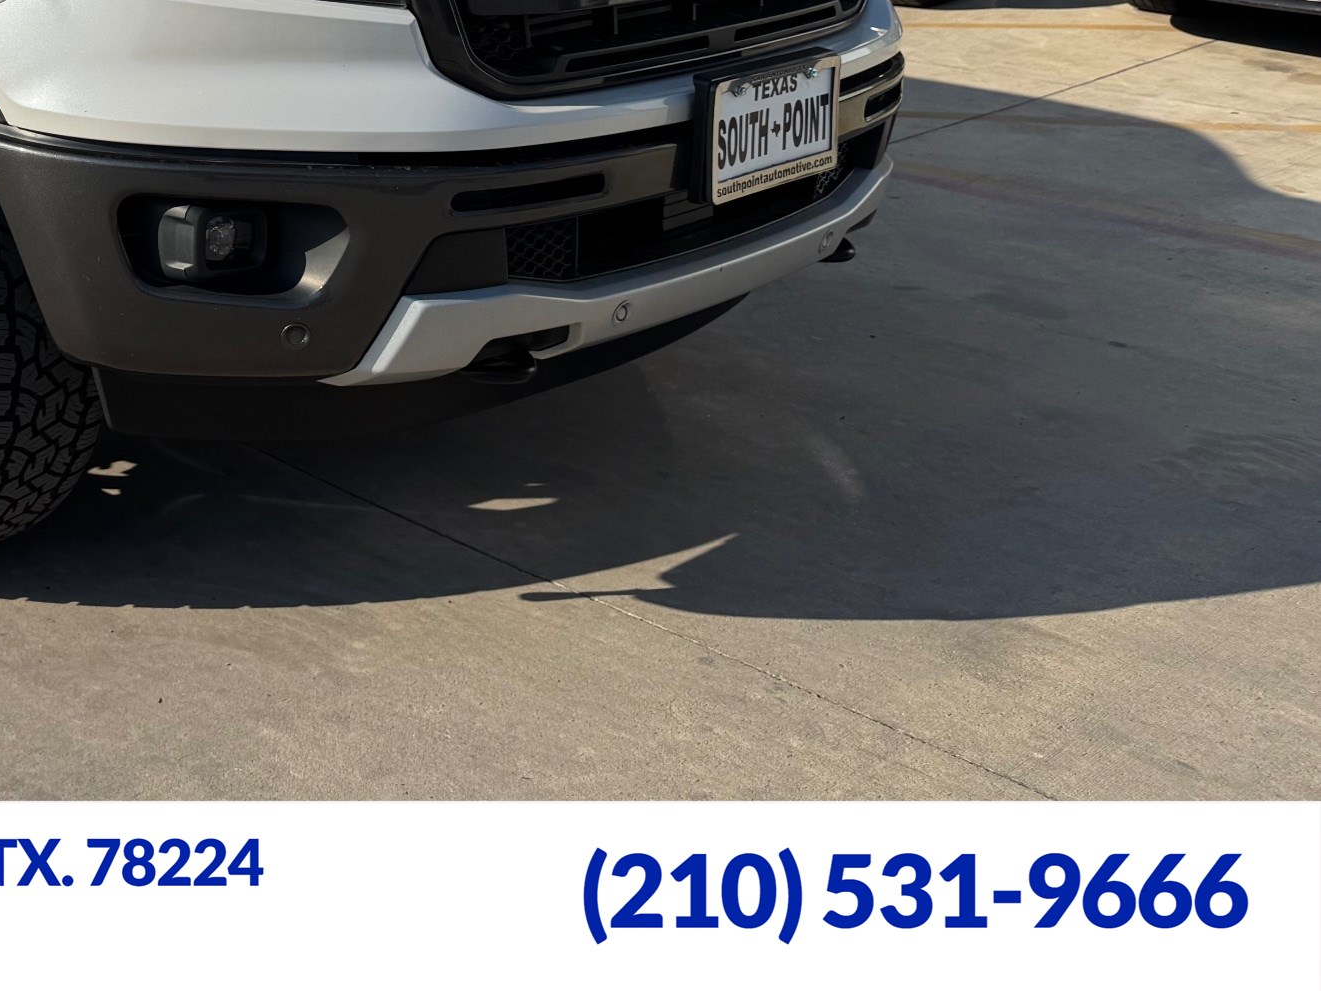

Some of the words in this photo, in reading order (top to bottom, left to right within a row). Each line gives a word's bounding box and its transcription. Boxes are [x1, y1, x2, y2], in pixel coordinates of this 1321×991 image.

[752, 74, 798, 101] TEXAS
[717, 108, 770, 170] SOUTH
[782, 93, 829, 150] POINT
[716, 155, 833, 198] southpointautomotive.com
